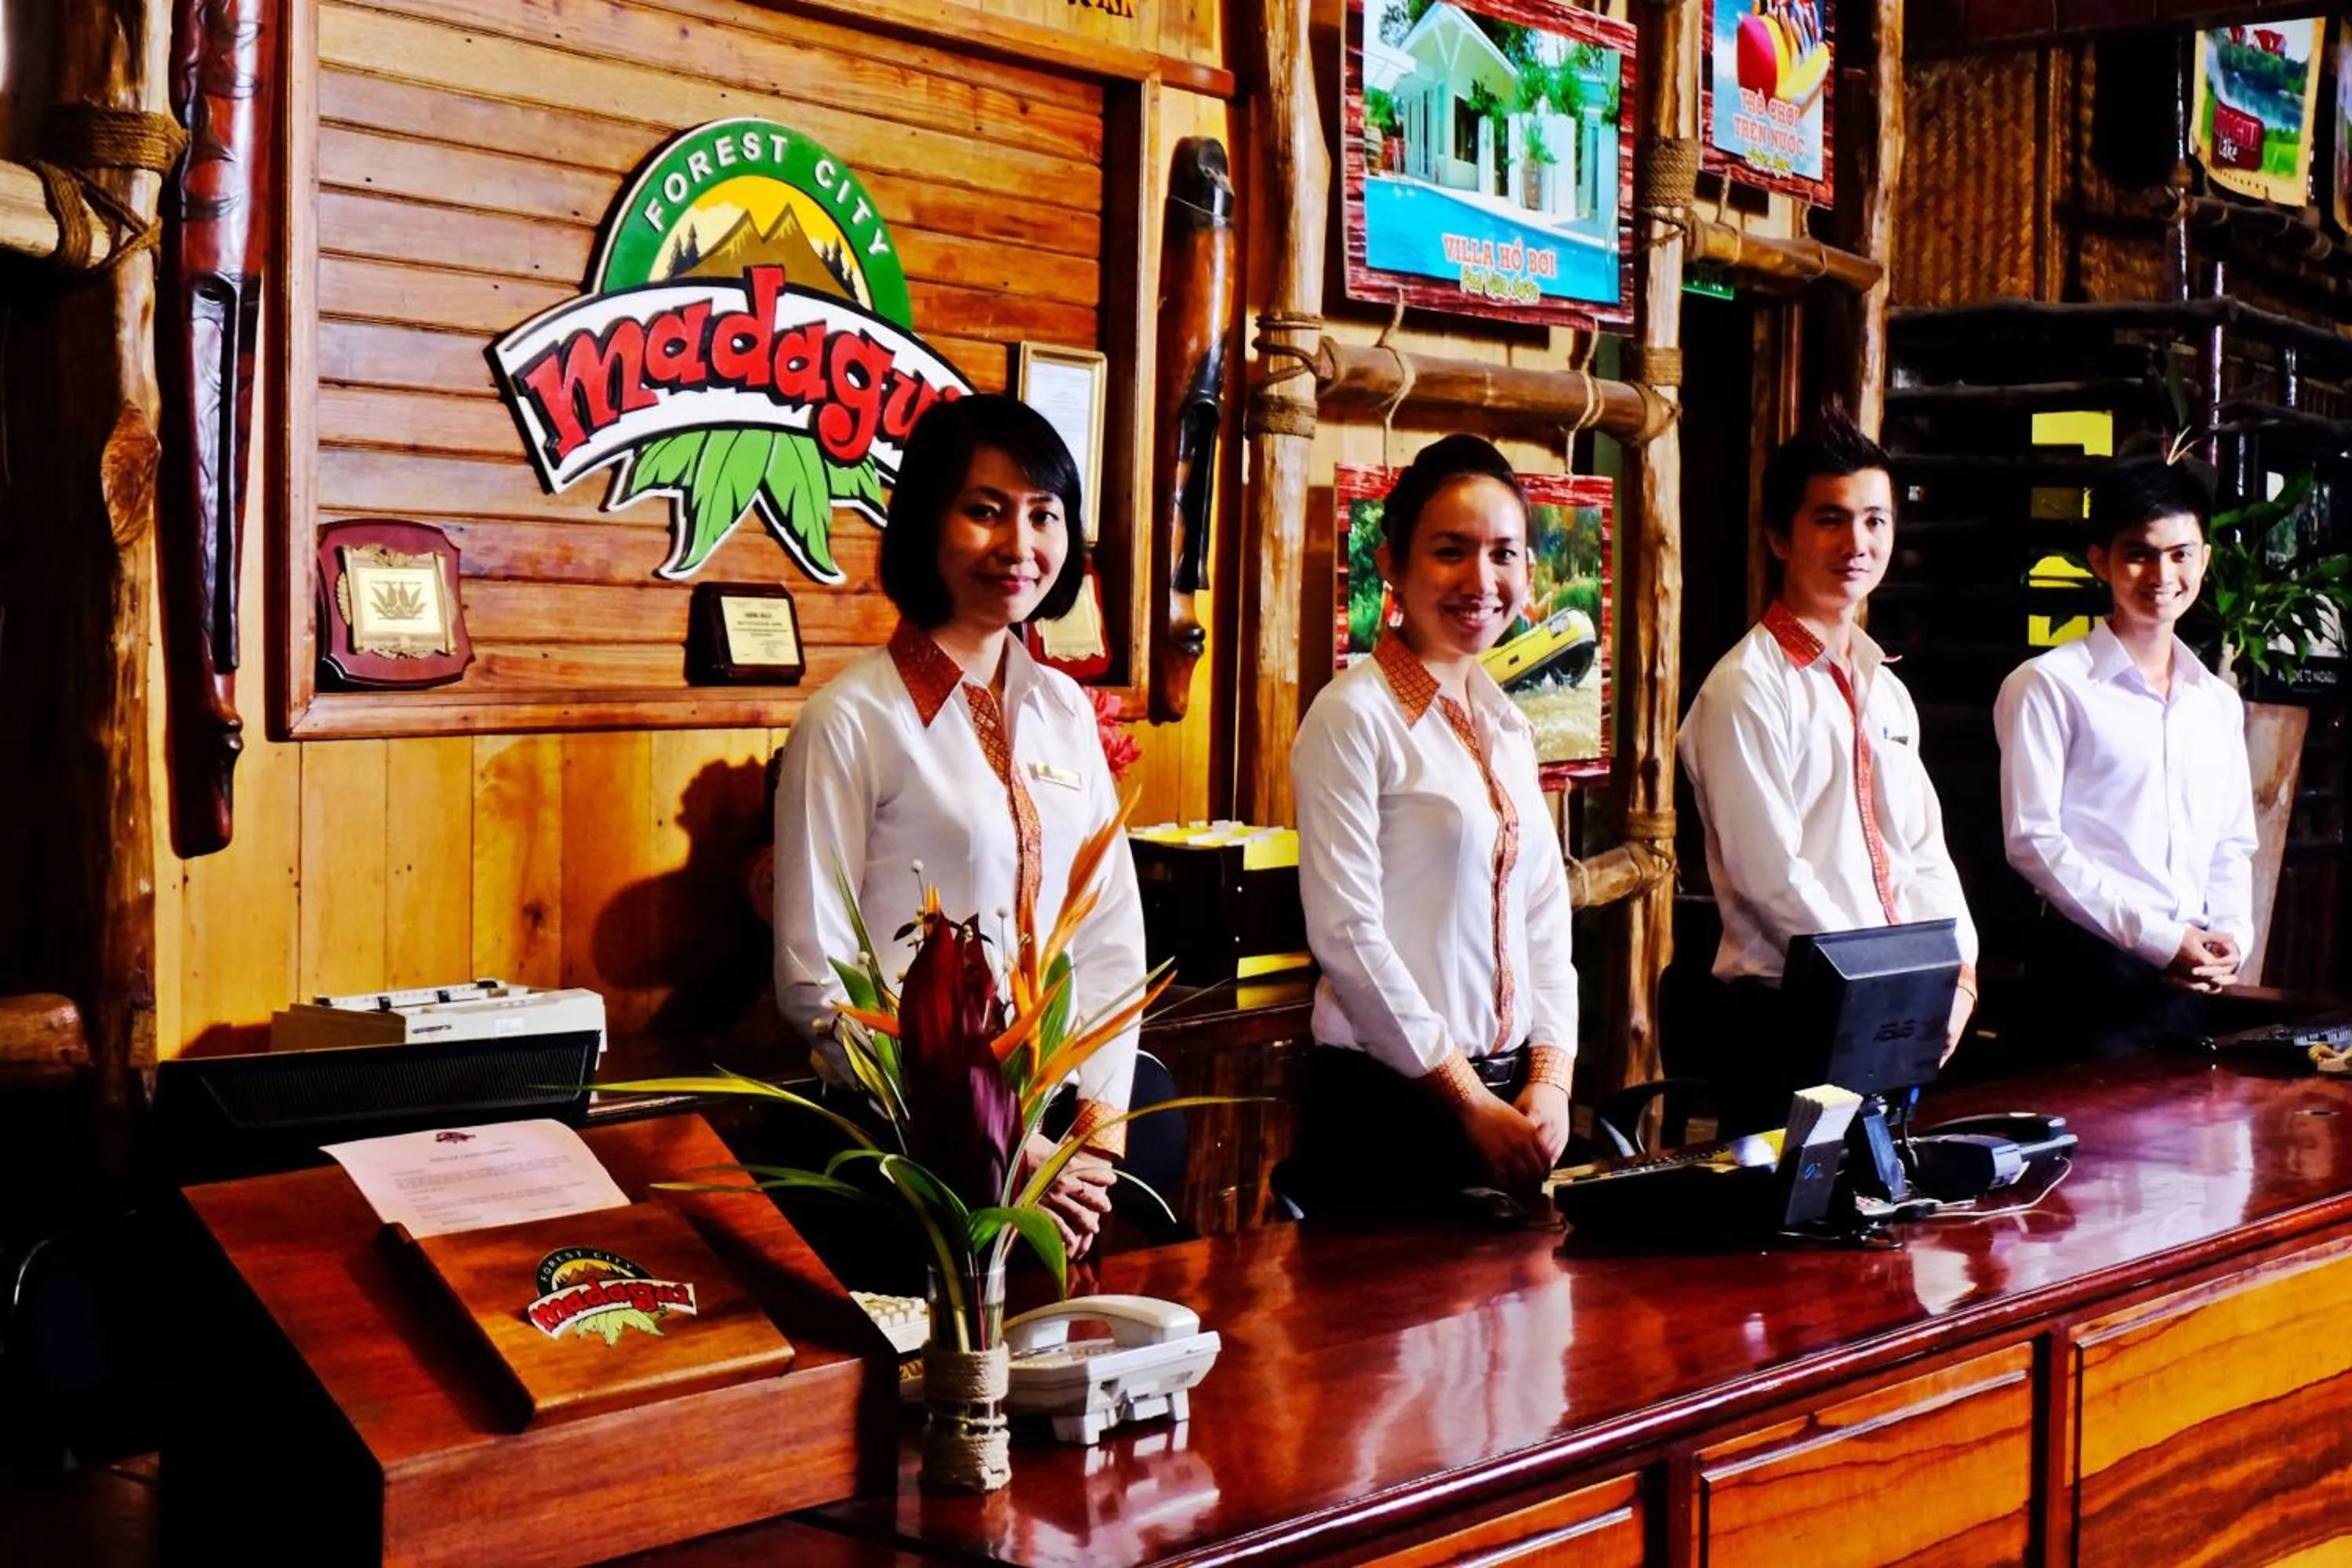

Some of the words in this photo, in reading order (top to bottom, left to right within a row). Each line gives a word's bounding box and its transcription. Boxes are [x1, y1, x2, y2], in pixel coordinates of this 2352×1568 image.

[644, 132, 788, 233] FOREST
[814, 158, 891, 256] CITY
[1443, 234, 1494, 267] VILLA
[524, 265, 961, 463] madagu
